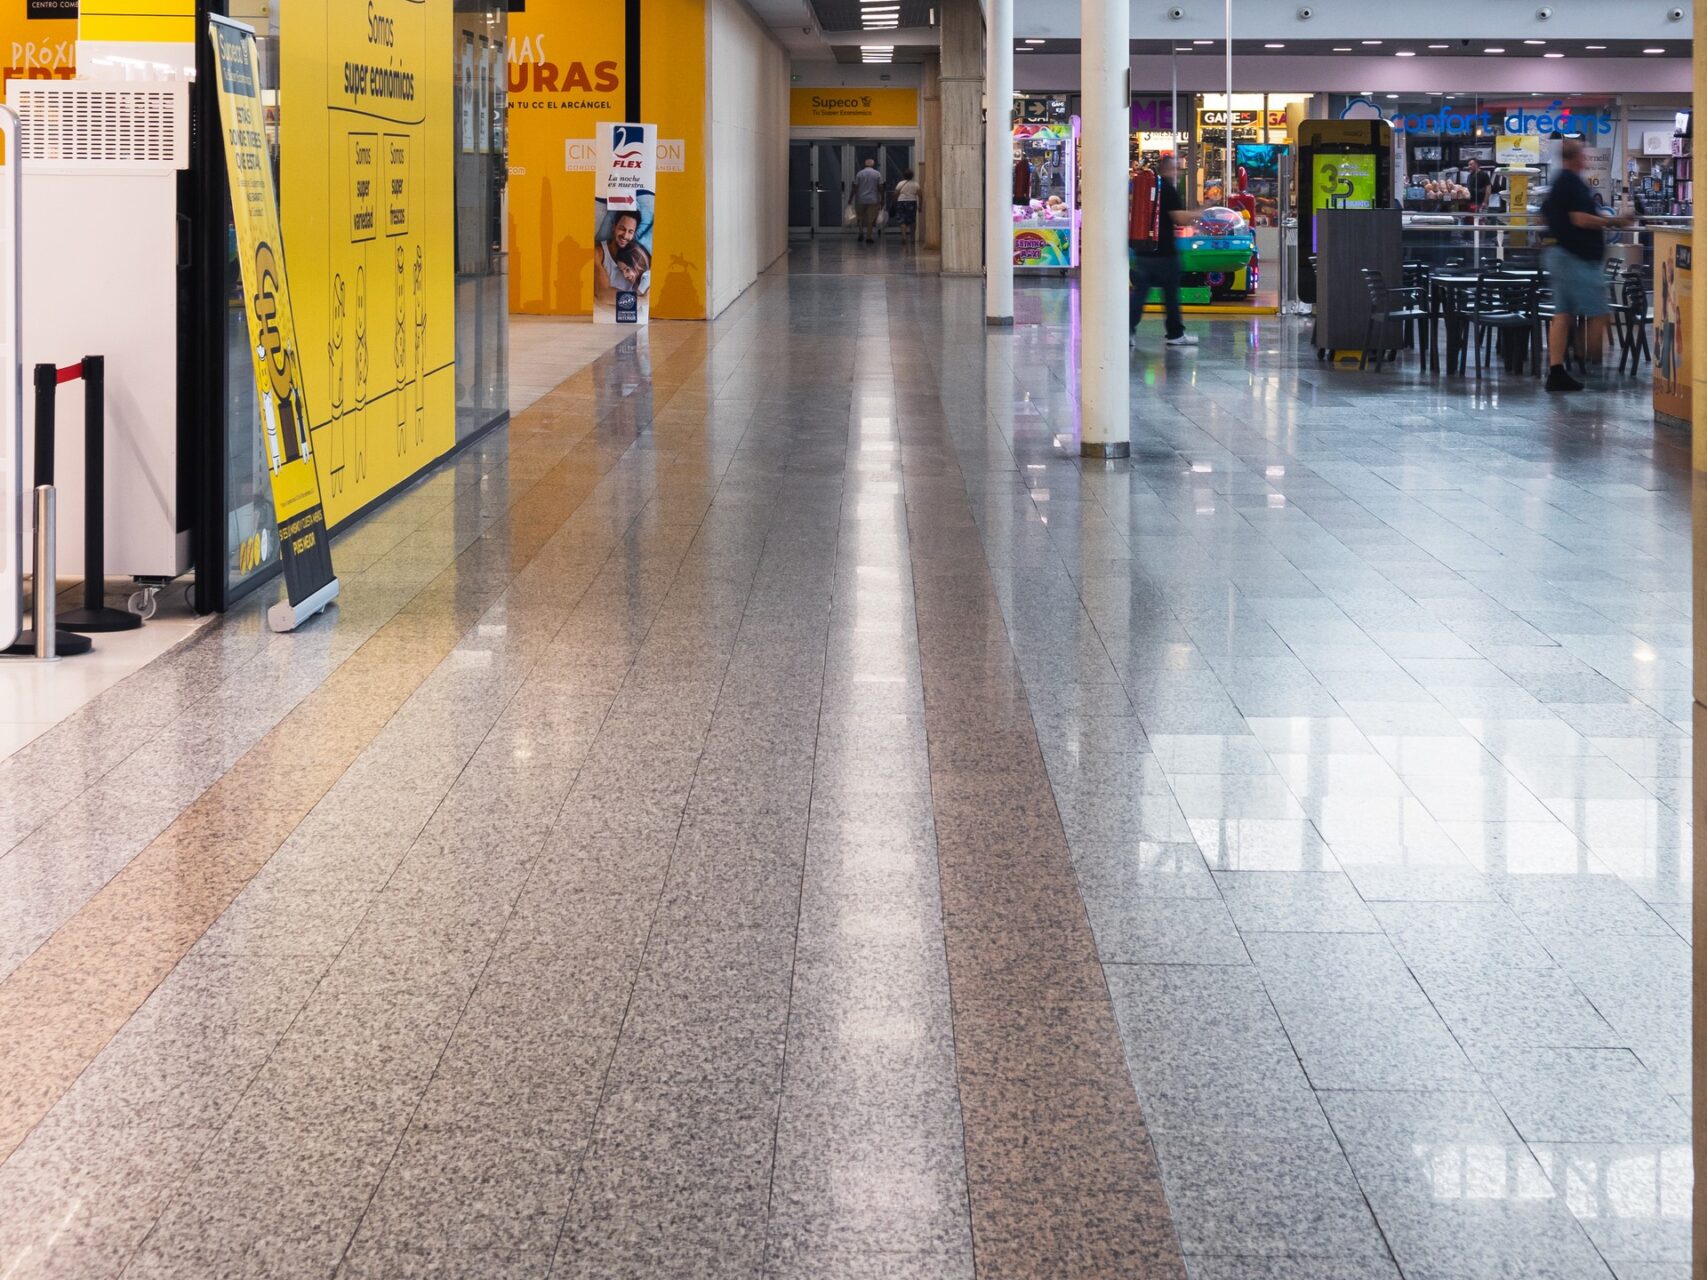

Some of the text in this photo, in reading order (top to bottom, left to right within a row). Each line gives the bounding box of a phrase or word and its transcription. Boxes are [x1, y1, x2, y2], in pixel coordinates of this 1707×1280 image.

[32, 1, 58, 9] CENTRO
[368, 0, 394, 48] Somos
[344, 55, 414, 105] super económicos
[561, 99, 611, 109] ARCÁNGEL
[811, 96, 859, 109] Supeco
[1204, 112, 1241, 124] GAME
[1391, 106, 1493, 134] confort
[613, 160, 642, 169] FLEX
[608, 174, 640, 182] La noche
